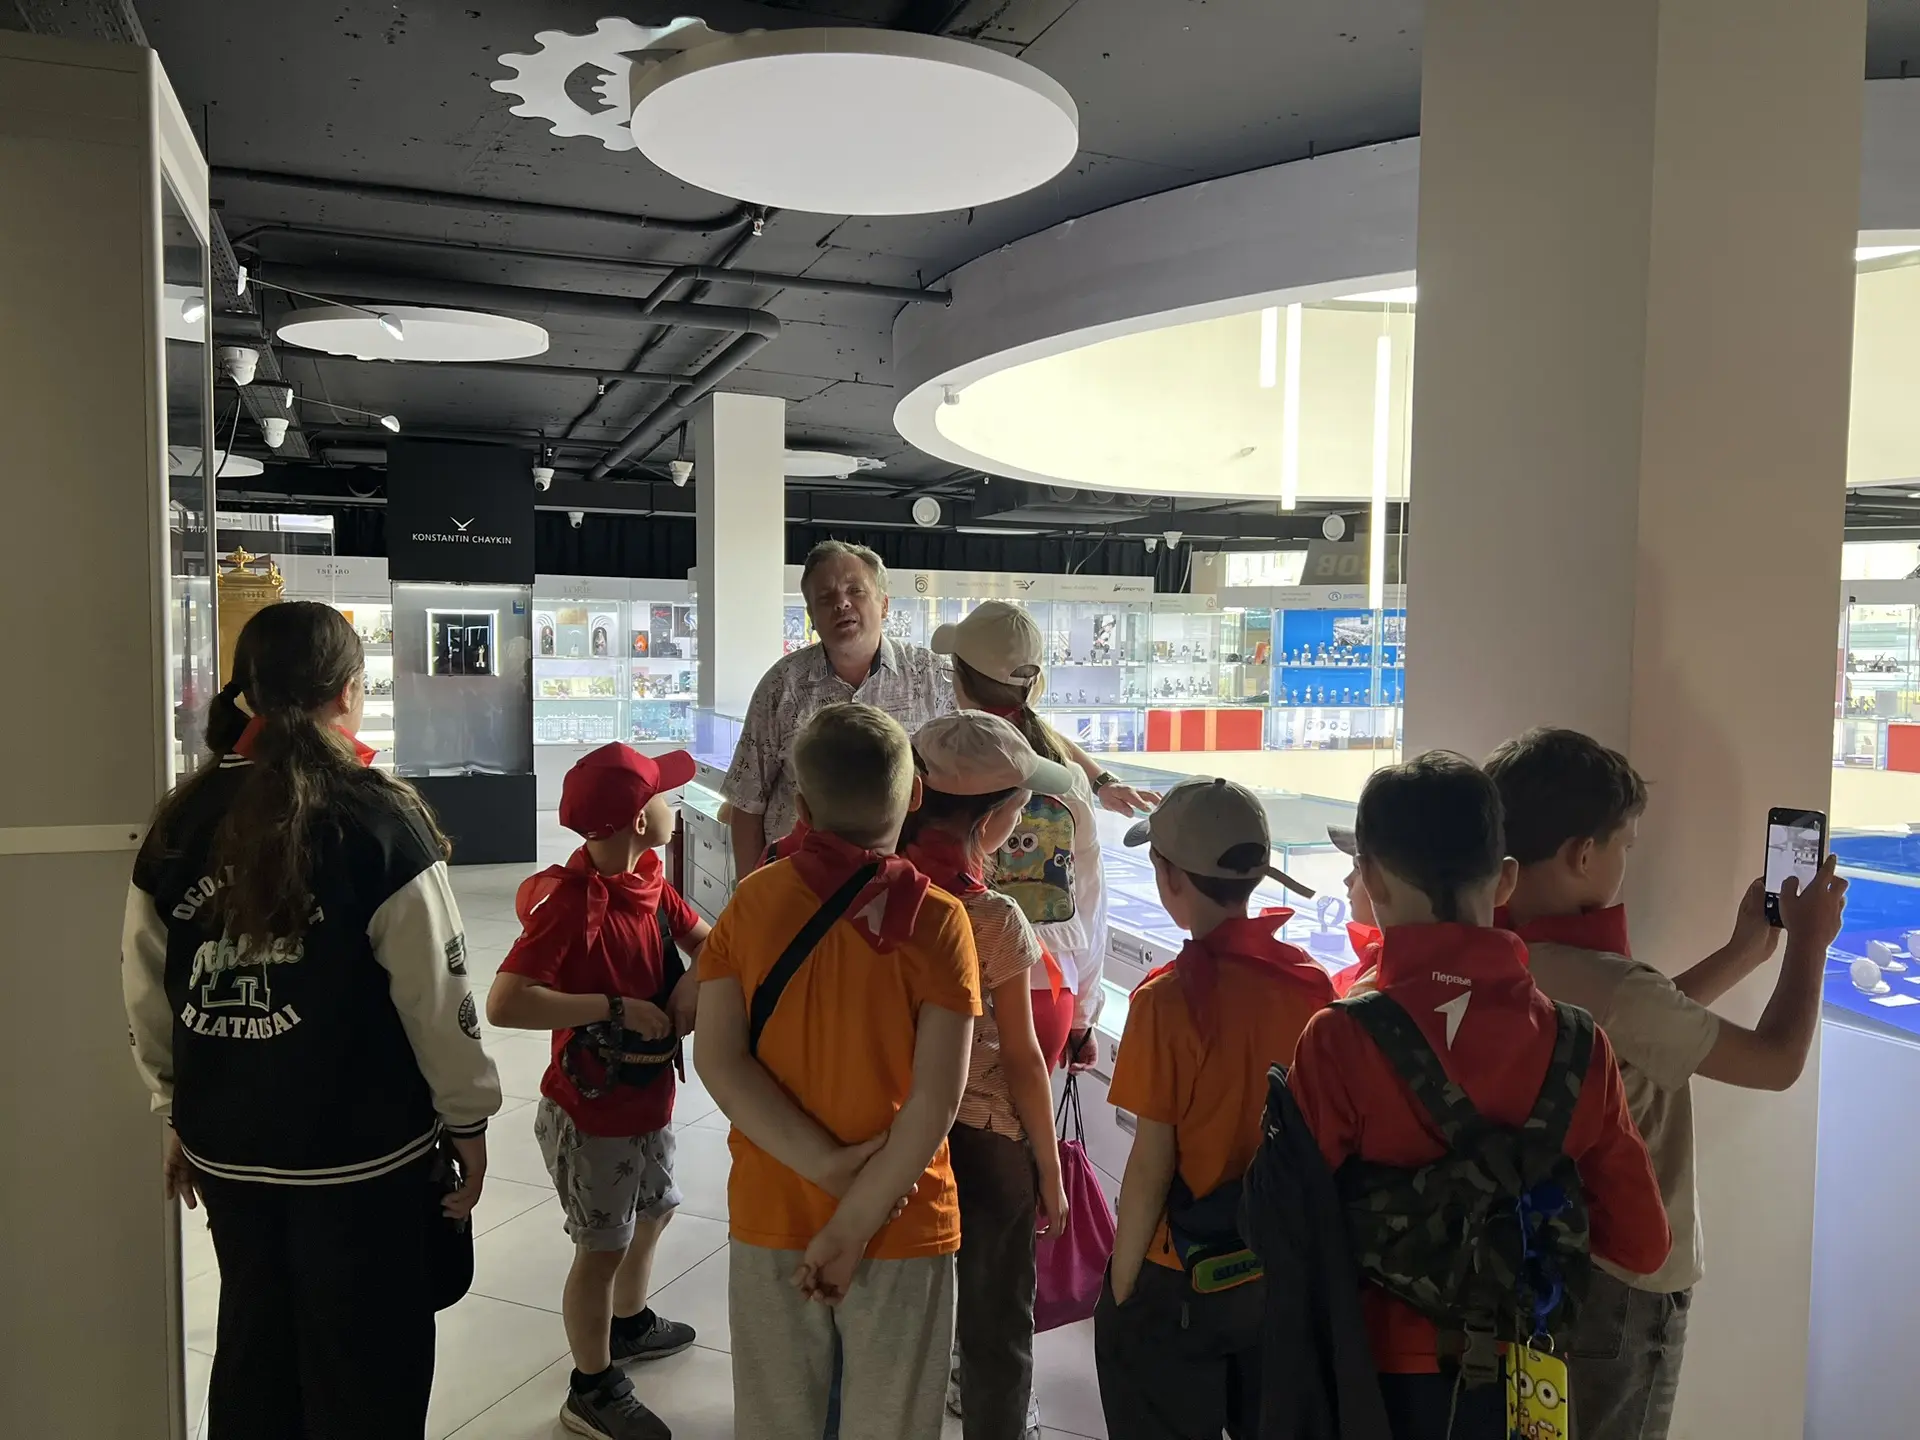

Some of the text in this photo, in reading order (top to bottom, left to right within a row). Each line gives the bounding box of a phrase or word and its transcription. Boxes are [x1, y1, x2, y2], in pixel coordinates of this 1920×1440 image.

[412, 533, 512, 545] KONSTANTIN CHAYKIN
[1431, 971, 1472, 987] Первые
